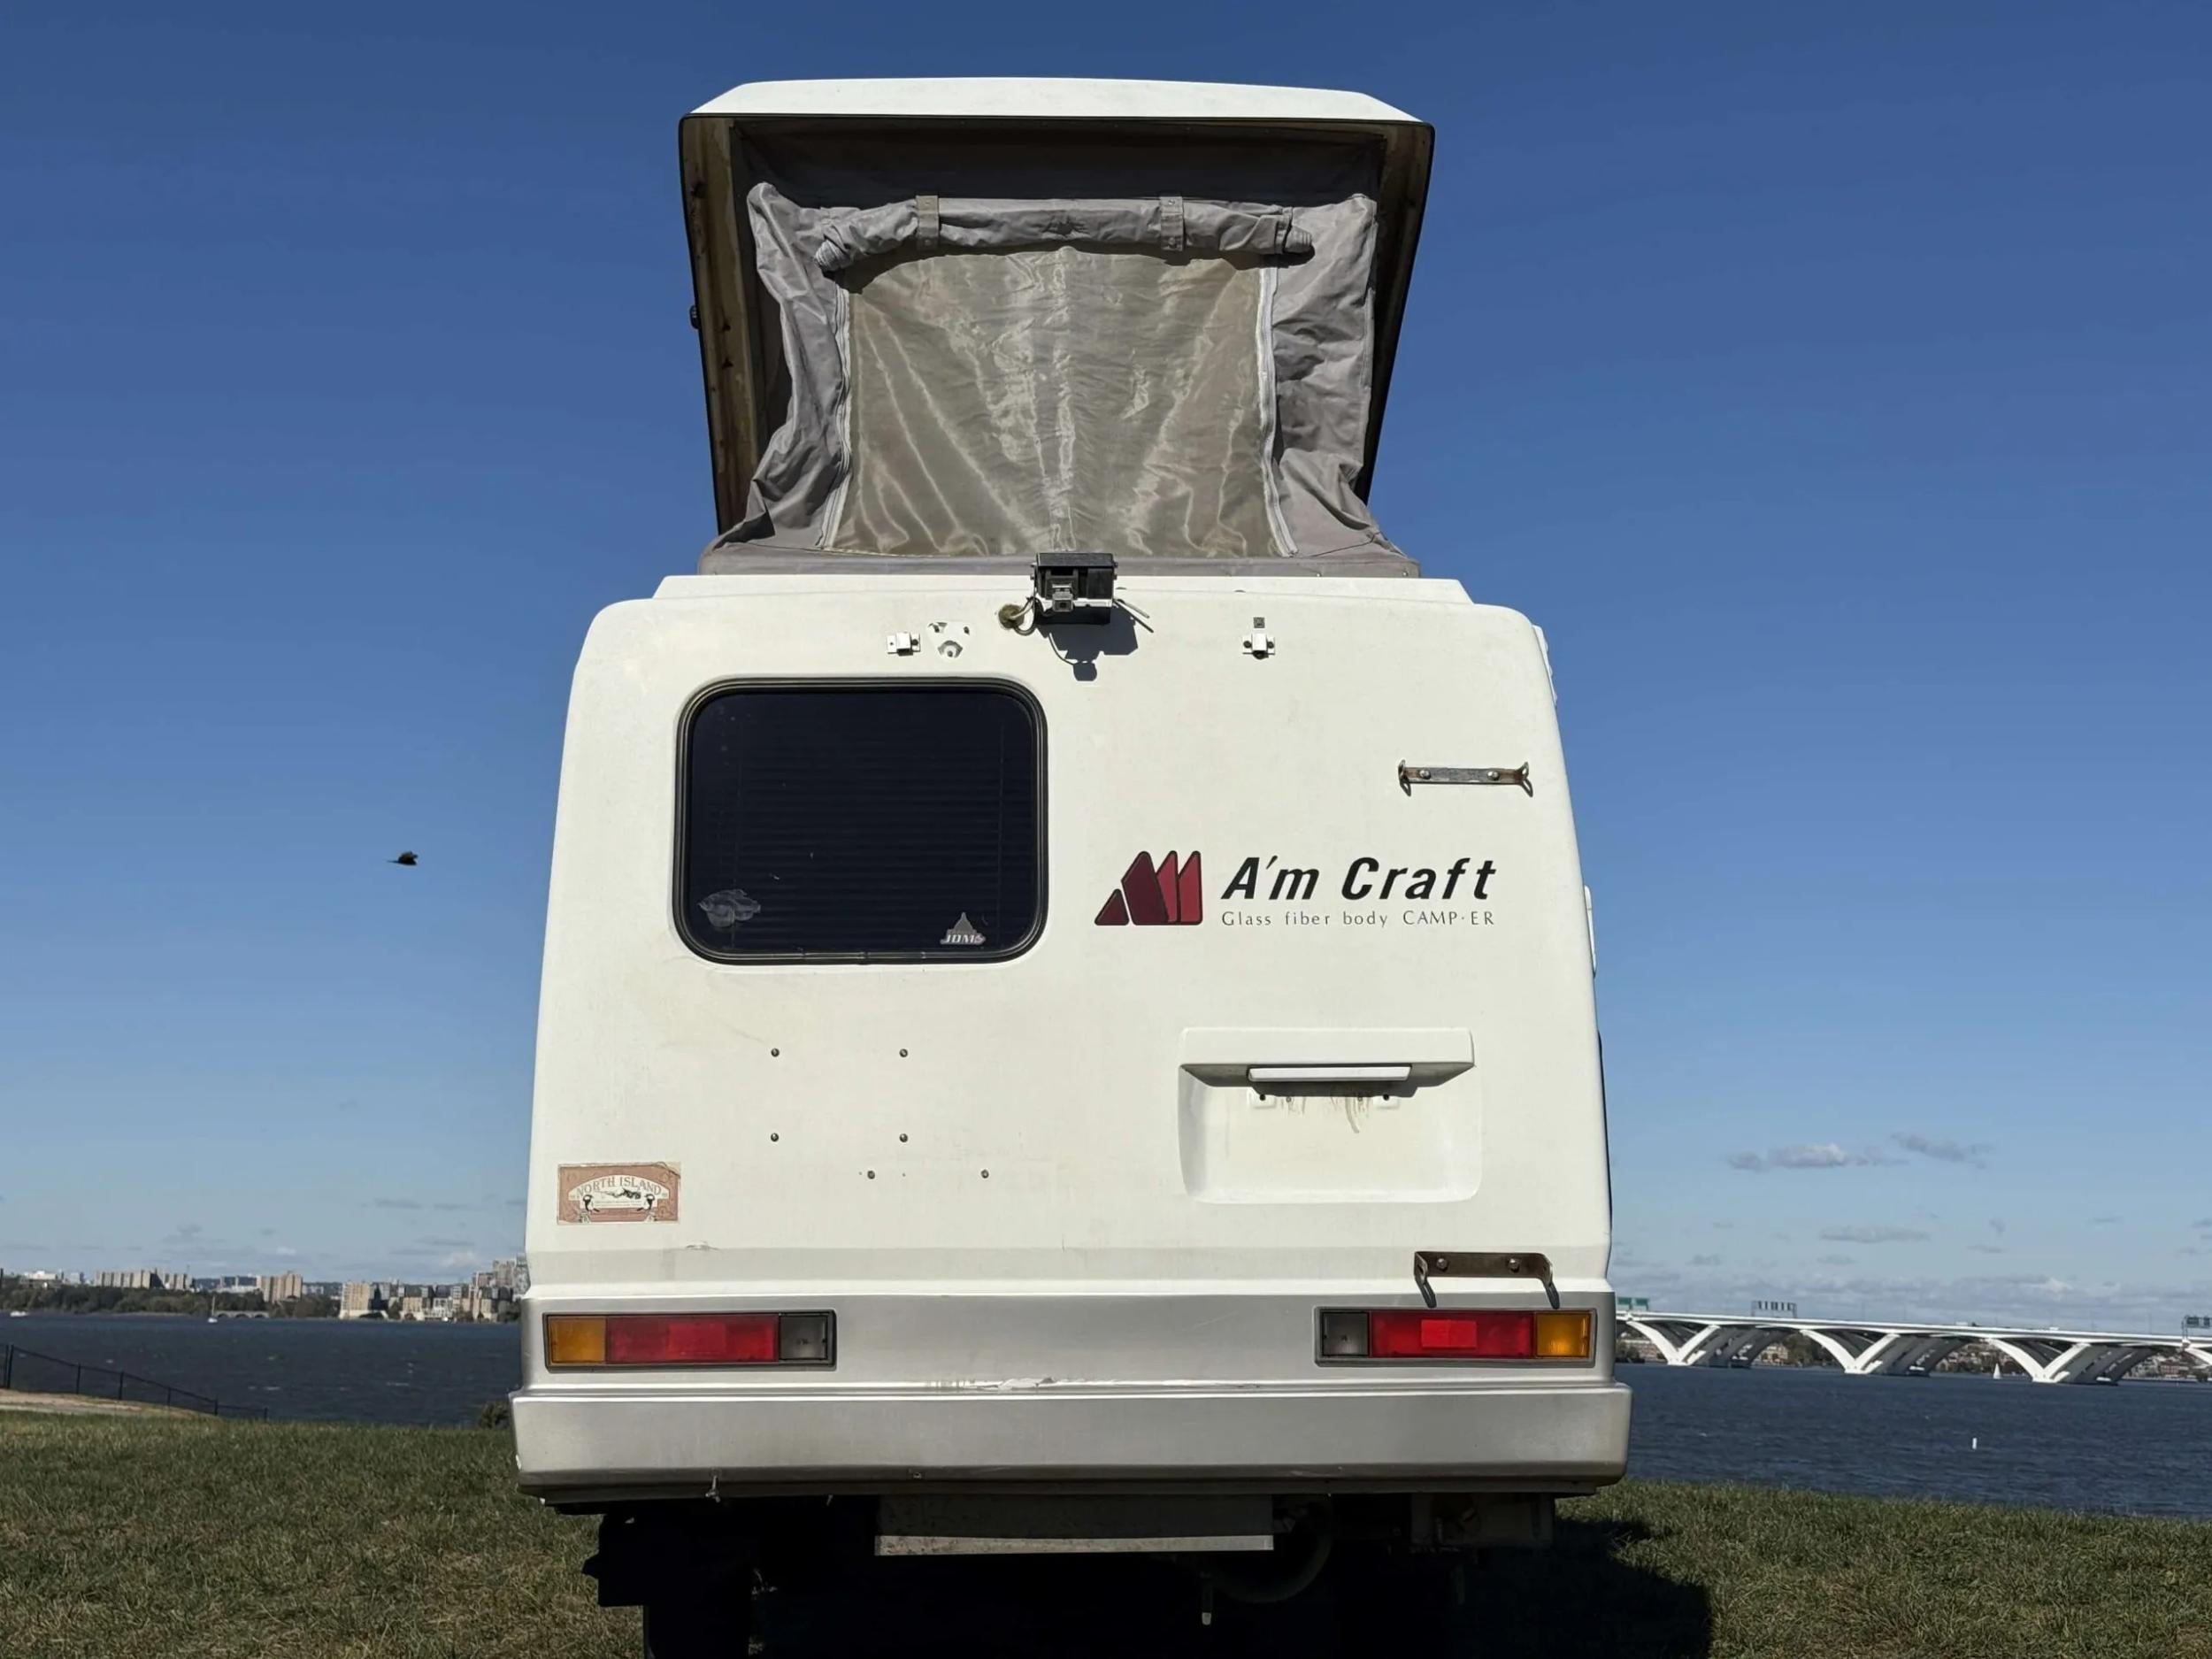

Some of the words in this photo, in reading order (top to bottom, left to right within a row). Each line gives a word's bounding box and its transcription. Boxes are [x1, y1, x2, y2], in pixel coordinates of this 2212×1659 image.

[1220, 855, 1320, 901] A'm
[1340, 856, 1497, 901] Craft
[1221, 910, 1272, 926] Glass
[1285, 910, 1331, 926] fiber
[1342, 910, 1388, 929] body
[577, 1177, 616, 1198] NORTH
[619, 1176, 662, 1196] ISLAND
